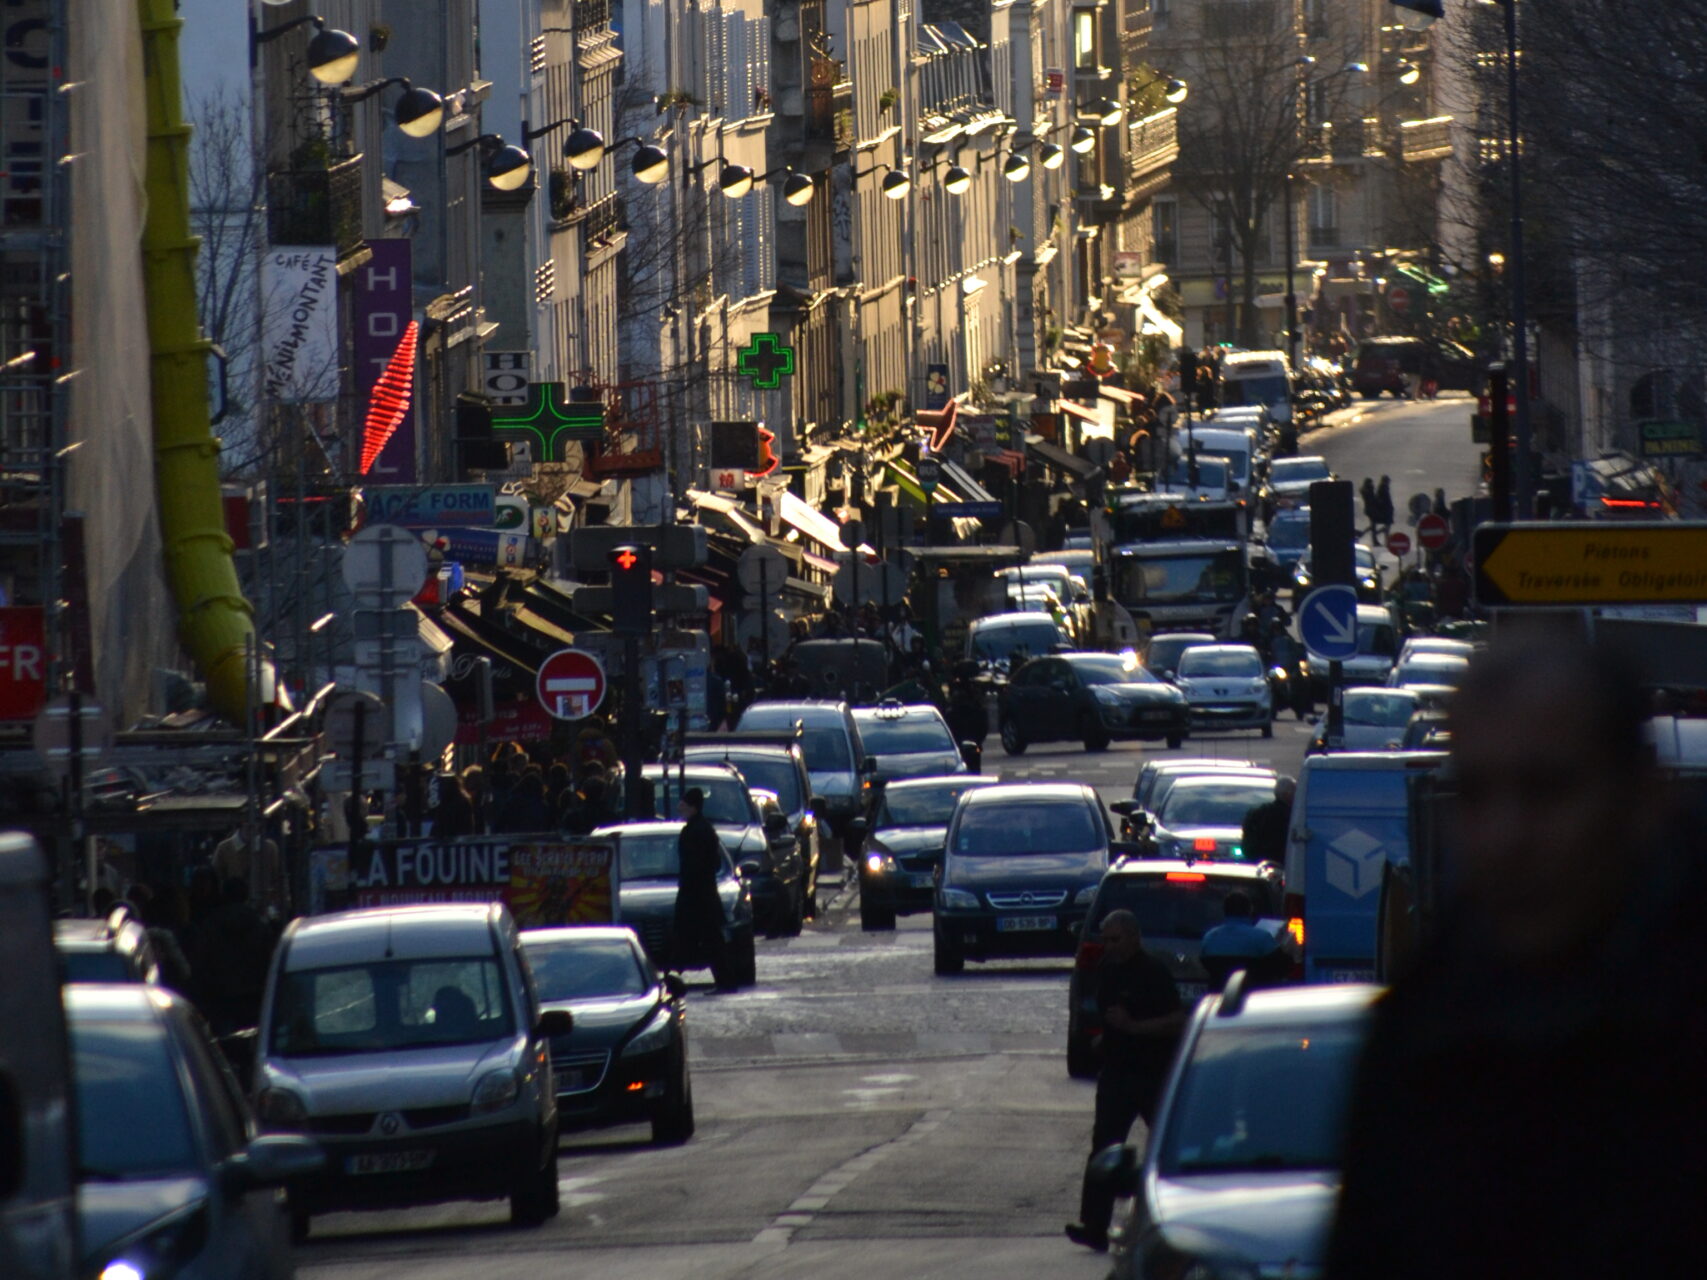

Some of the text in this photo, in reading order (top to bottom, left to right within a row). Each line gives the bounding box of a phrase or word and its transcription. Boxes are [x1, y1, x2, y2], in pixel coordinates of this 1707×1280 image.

[275, 253, 310, 271] CAFÉ
[367, 266, 398, 474] HOTL
[431, 492, 490, 509] FORM
[396, 844, 509, 886] FOUINE
